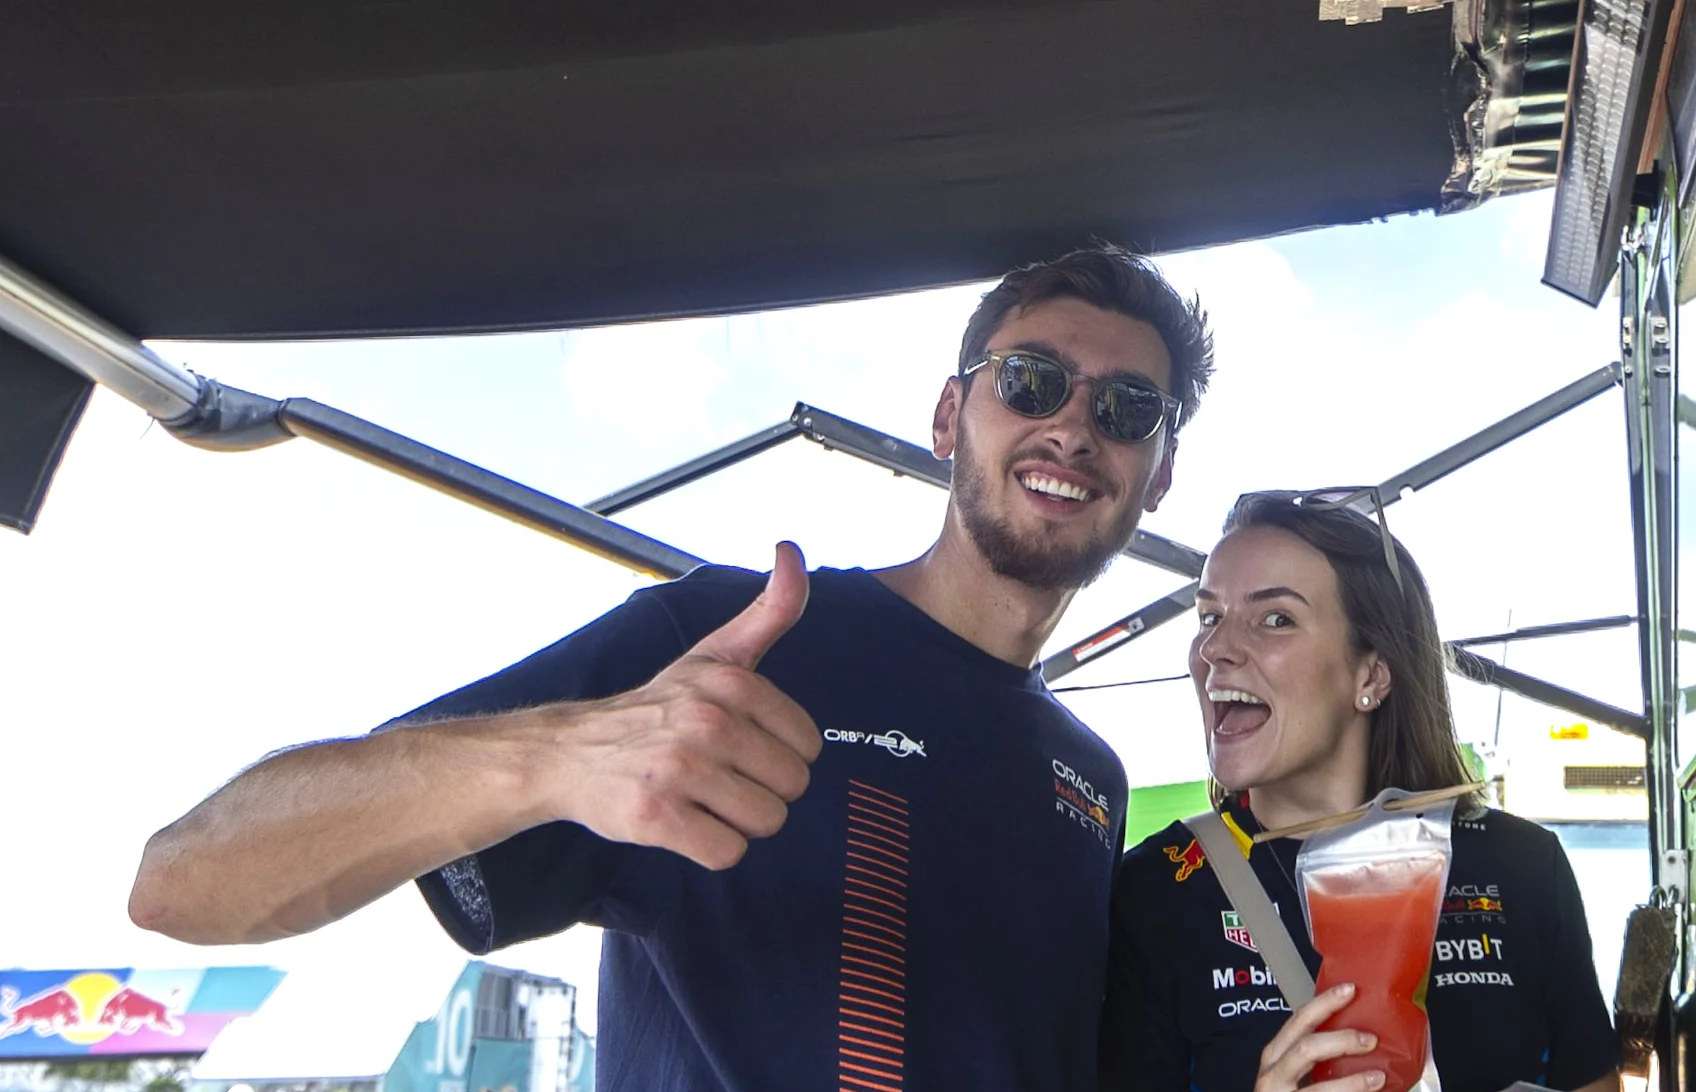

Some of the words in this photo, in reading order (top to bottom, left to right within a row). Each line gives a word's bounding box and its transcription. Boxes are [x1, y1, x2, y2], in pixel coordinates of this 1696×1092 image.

[1052, 758, 1110, 812] ORACLE
[1056, 801, 1111, 850] RACING
[1447, 884, 1500, 897] ACLE
[1439, 914, 1507, 925] ACING
[1434, 933, 1503, 962] BYBIT
[1434, 971, 1515, 988] HONDA
[1218, 997, 1294, 1018] ORACL
